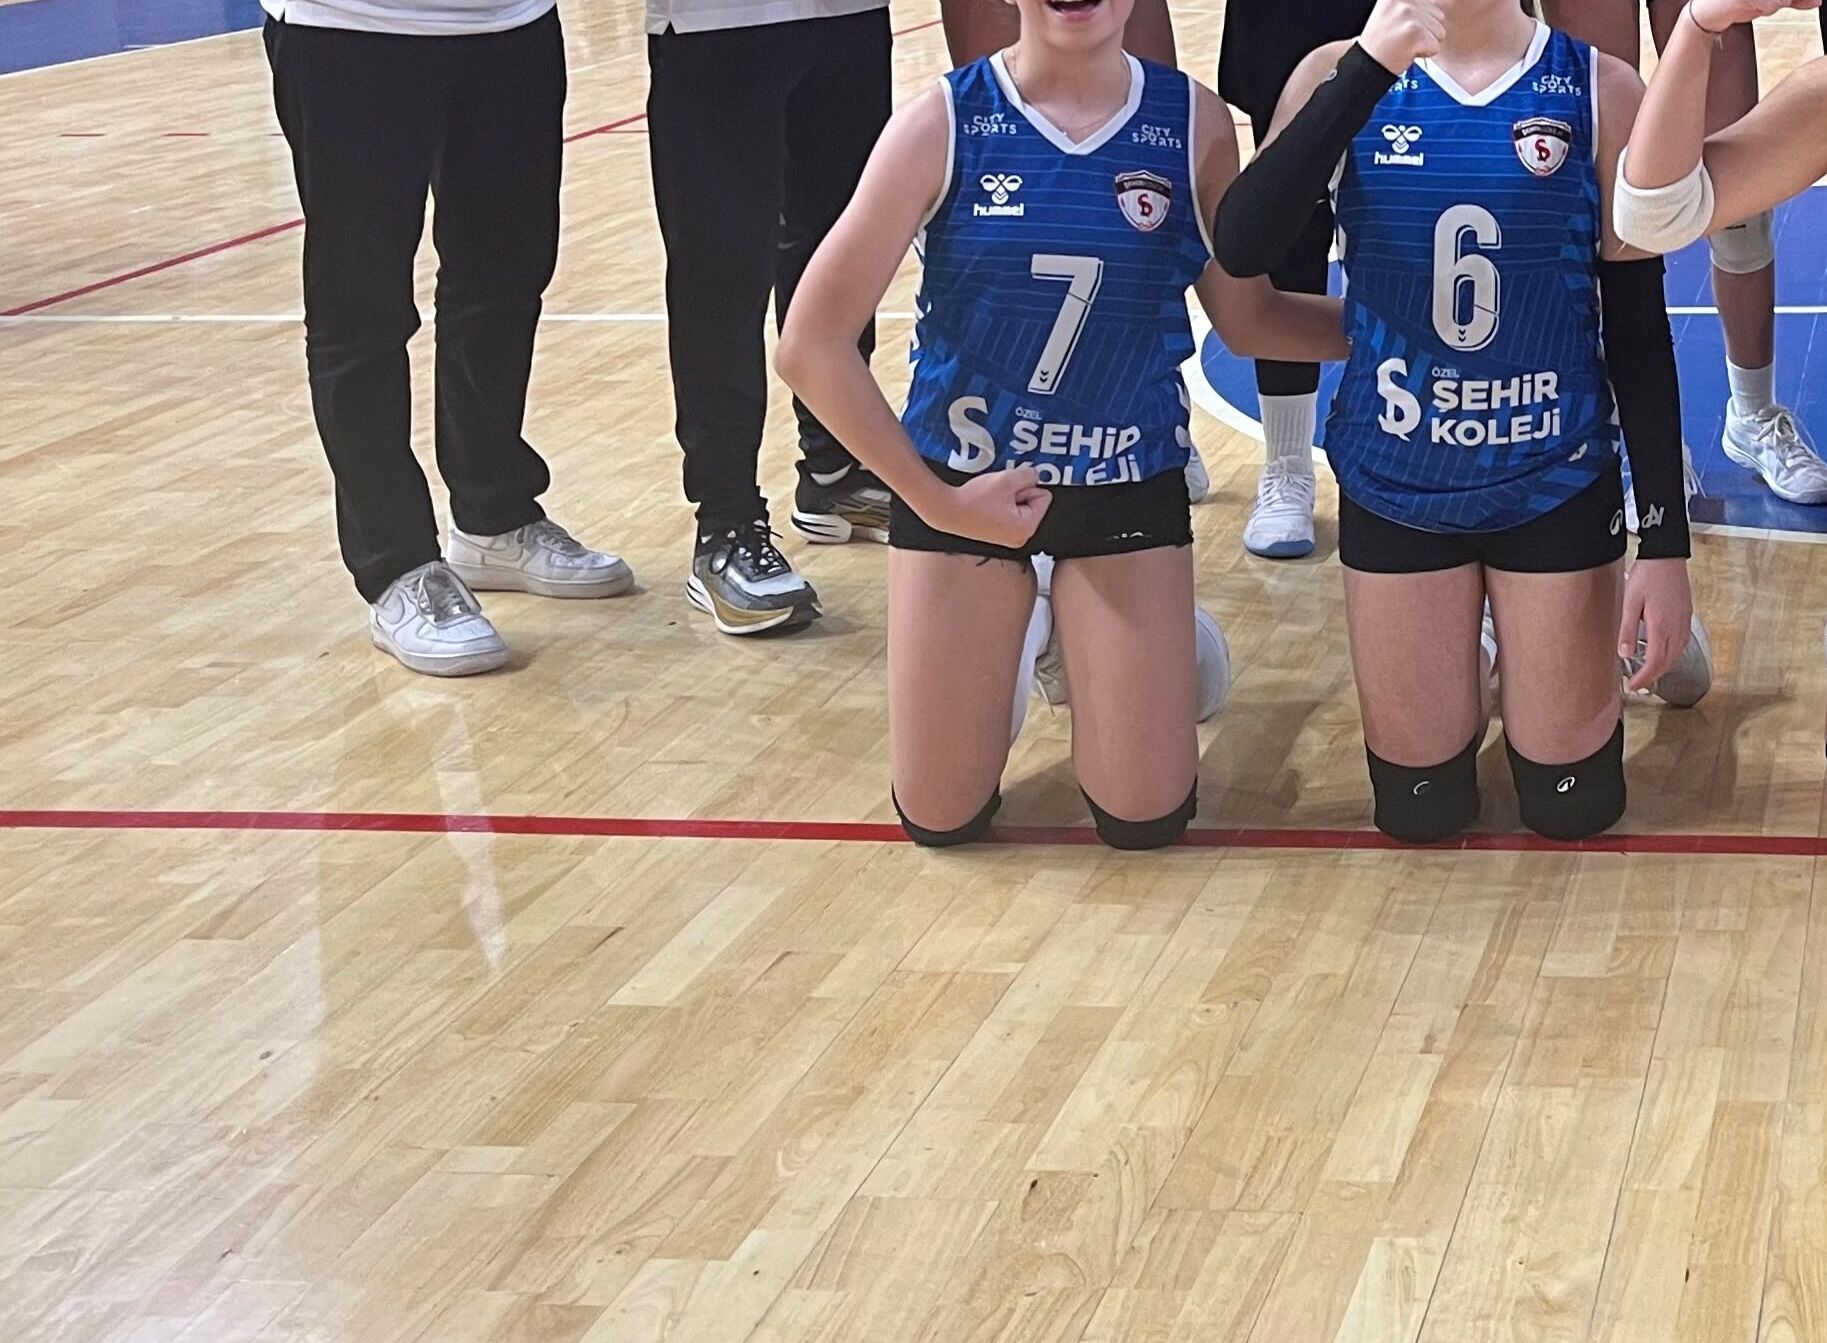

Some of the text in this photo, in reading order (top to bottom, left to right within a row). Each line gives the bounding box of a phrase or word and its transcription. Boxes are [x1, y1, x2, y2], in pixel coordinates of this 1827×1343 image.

[1541, 74, 1572, 86] CITY
[1532, 82, 1582, 96] SPORTS
[973, 113, 1005, 125] CITY
[1141, 124, 1171, 137] CITY
[1132, 132, 1182, 149] SPORTS
[1374, 151, 1424, 166] hummel
[973, 203, 1025, 216] hummel
[1431, 203, 1501, 352] 6
[1029, 253, 1104, 395] 7
[1432, 371, 1559, 413] ŞEHİR
[1431, 408, 1560, 446] KOLEJİ
